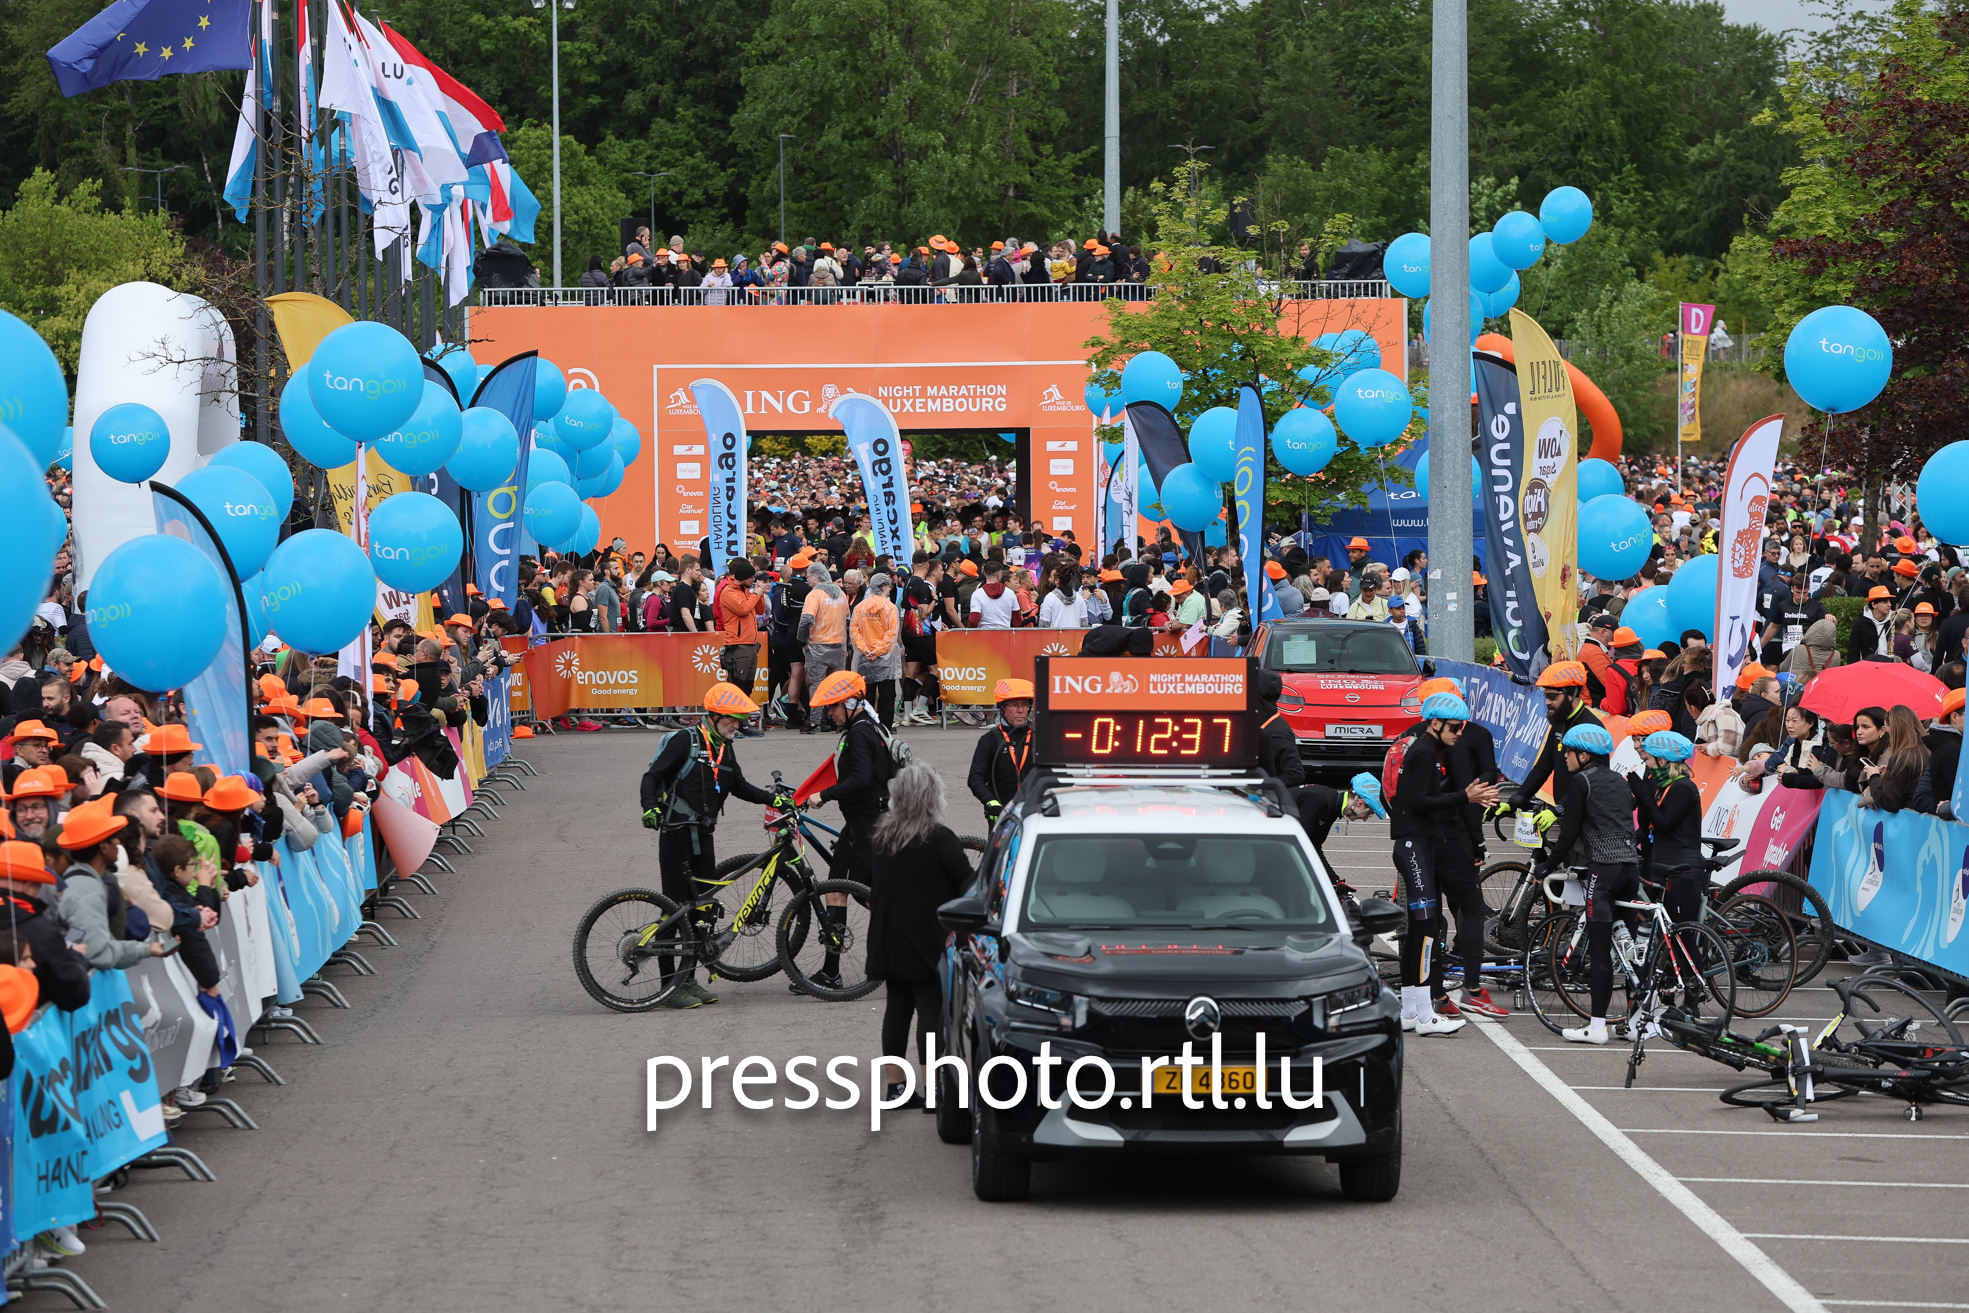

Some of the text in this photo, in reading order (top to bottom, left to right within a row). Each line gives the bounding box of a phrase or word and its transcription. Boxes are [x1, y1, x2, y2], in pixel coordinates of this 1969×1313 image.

[1690, 307, 1704, 334] D
[1820, 338, 1878, 363] tango
[323, 370, 397, 400] tango
[878, 385, 1007, 397] NIGHT MARATHON
[743, 390, 812, 414] ING
[1356, 387, 1401, 404] tango
[564, 415, 598, 431] tango
[109, 431, 155, 446] tango
[1286, 438, 1322, 453] tango
[1609, 527, 1648, 554] tango
[373, 540, 440, 567] tango
[576, 669, 639, 686] enovos
[938, 666, 987, 682] novos
[1149, 673, 1244, 683] NIGHT MARATHON
[613, 689, 639, 697] energy
[961, 685, 987, 693] energy
[1052, 675, 1103, 694] ING
[1149, 683, 1244, 695] LUXEMBOURG
[1065, 717, 1232, 755] -0:12:37
[1333, 726, 1375, 735] MICRA
[1707, 806, 1729, 836] ING
[1769, 805, 1786, 832] Get
[735, 871, 774, 931] devinci
